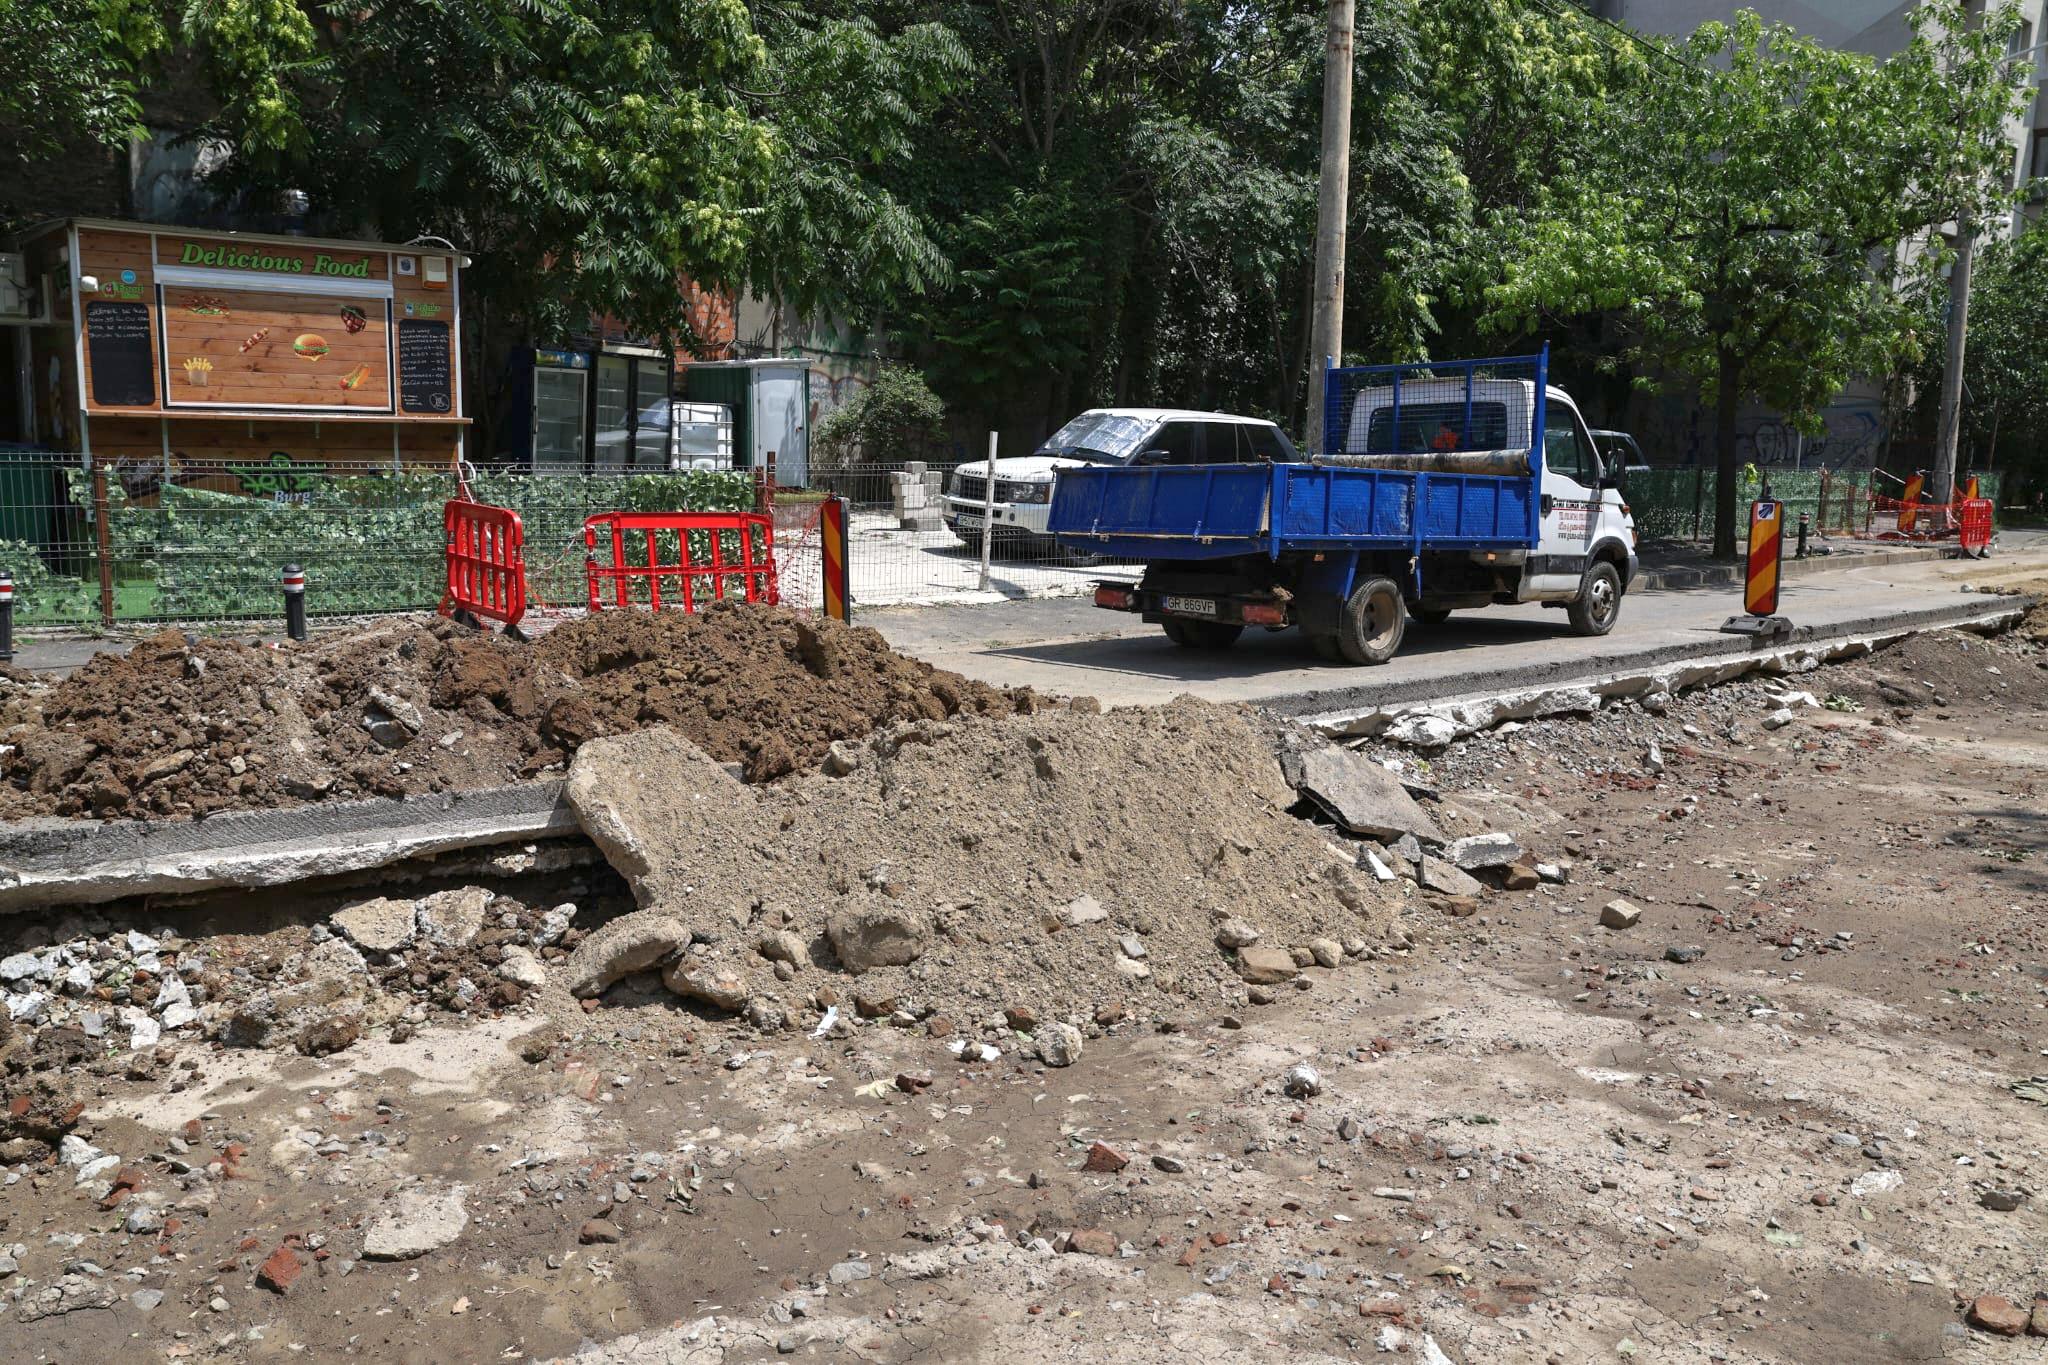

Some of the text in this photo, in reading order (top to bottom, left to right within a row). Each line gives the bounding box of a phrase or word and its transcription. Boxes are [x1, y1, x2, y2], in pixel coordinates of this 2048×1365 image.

[180, 243, 371, 278] Delicious Food
[1168, 597, 1181, 609] GR
